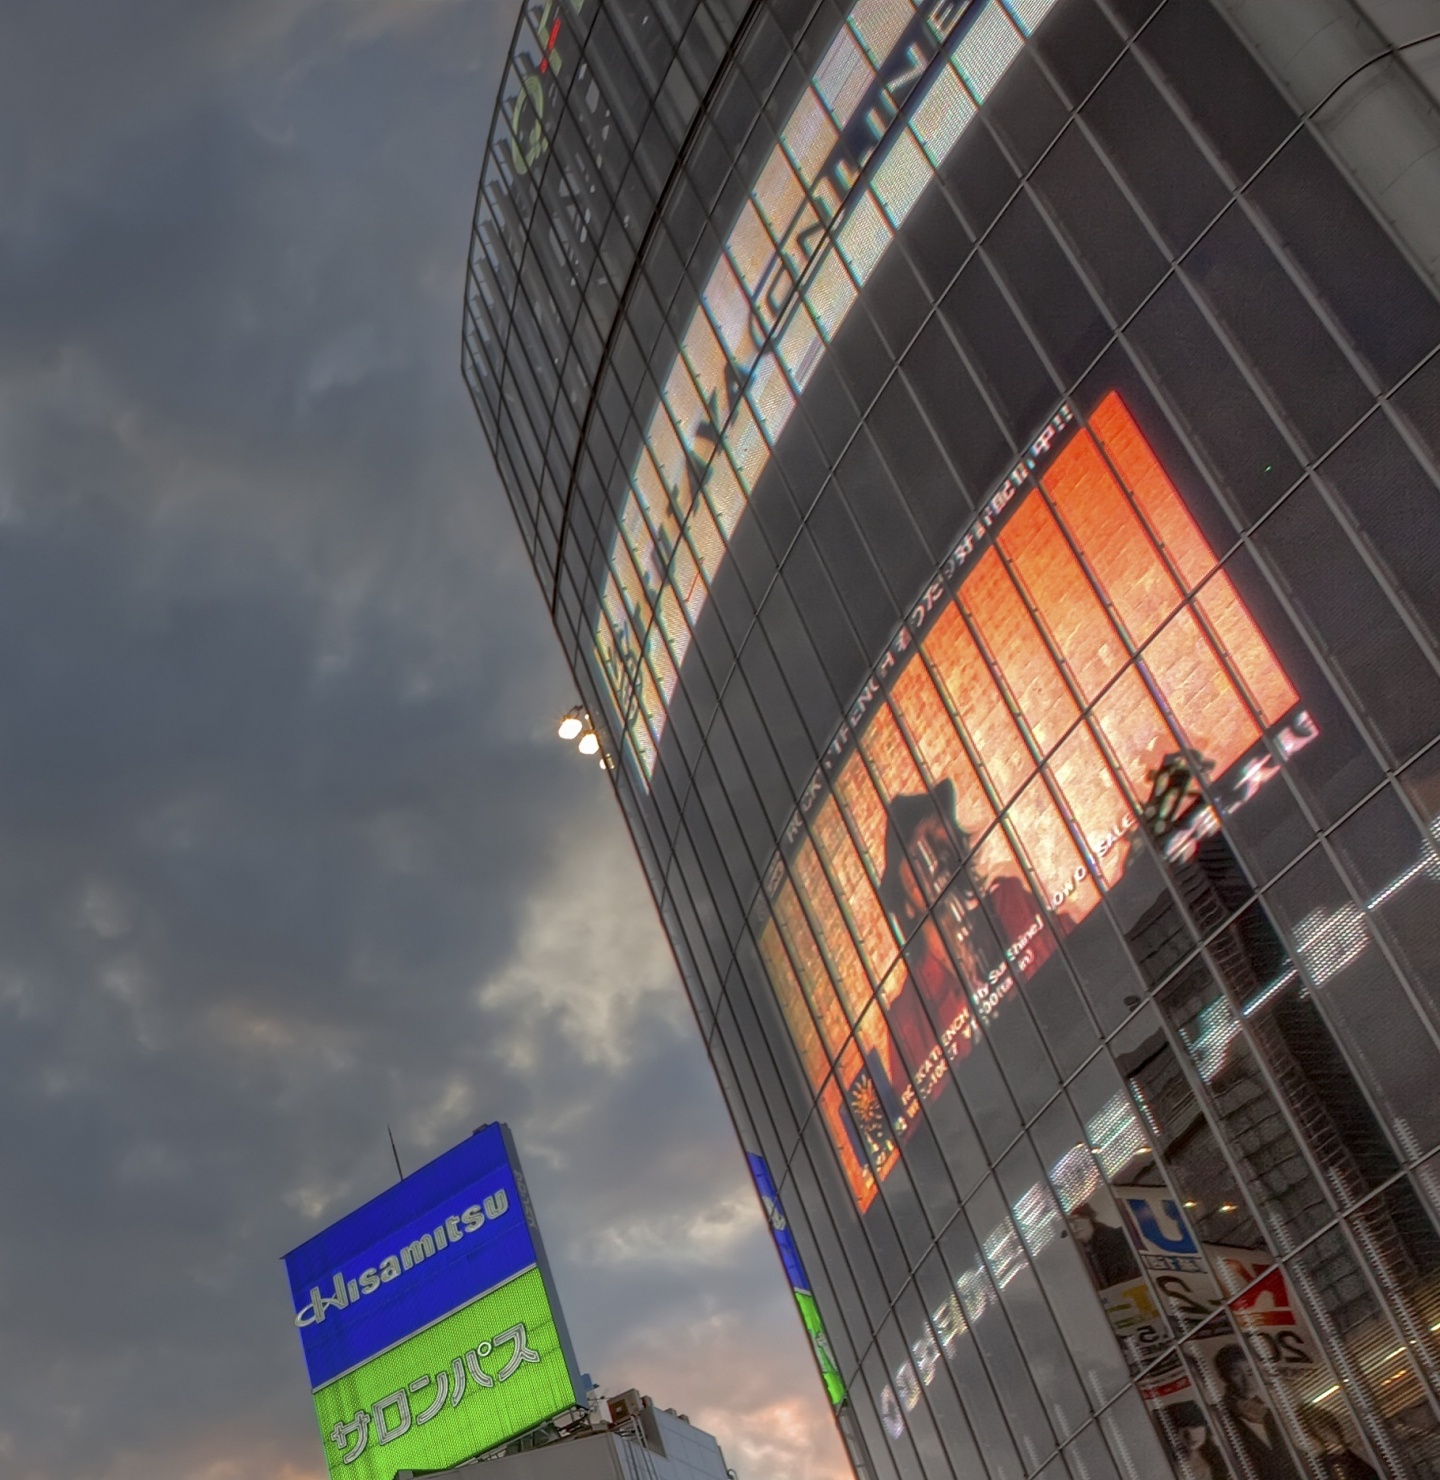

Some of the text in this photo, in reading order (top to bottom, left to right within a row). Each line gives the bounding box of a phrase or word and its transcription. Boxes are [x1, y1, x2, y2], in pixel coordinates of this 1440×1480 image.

[294, 1187, 510, 1329] Hisamitsu
[329, 1322, 541, 1465] サロンパス
